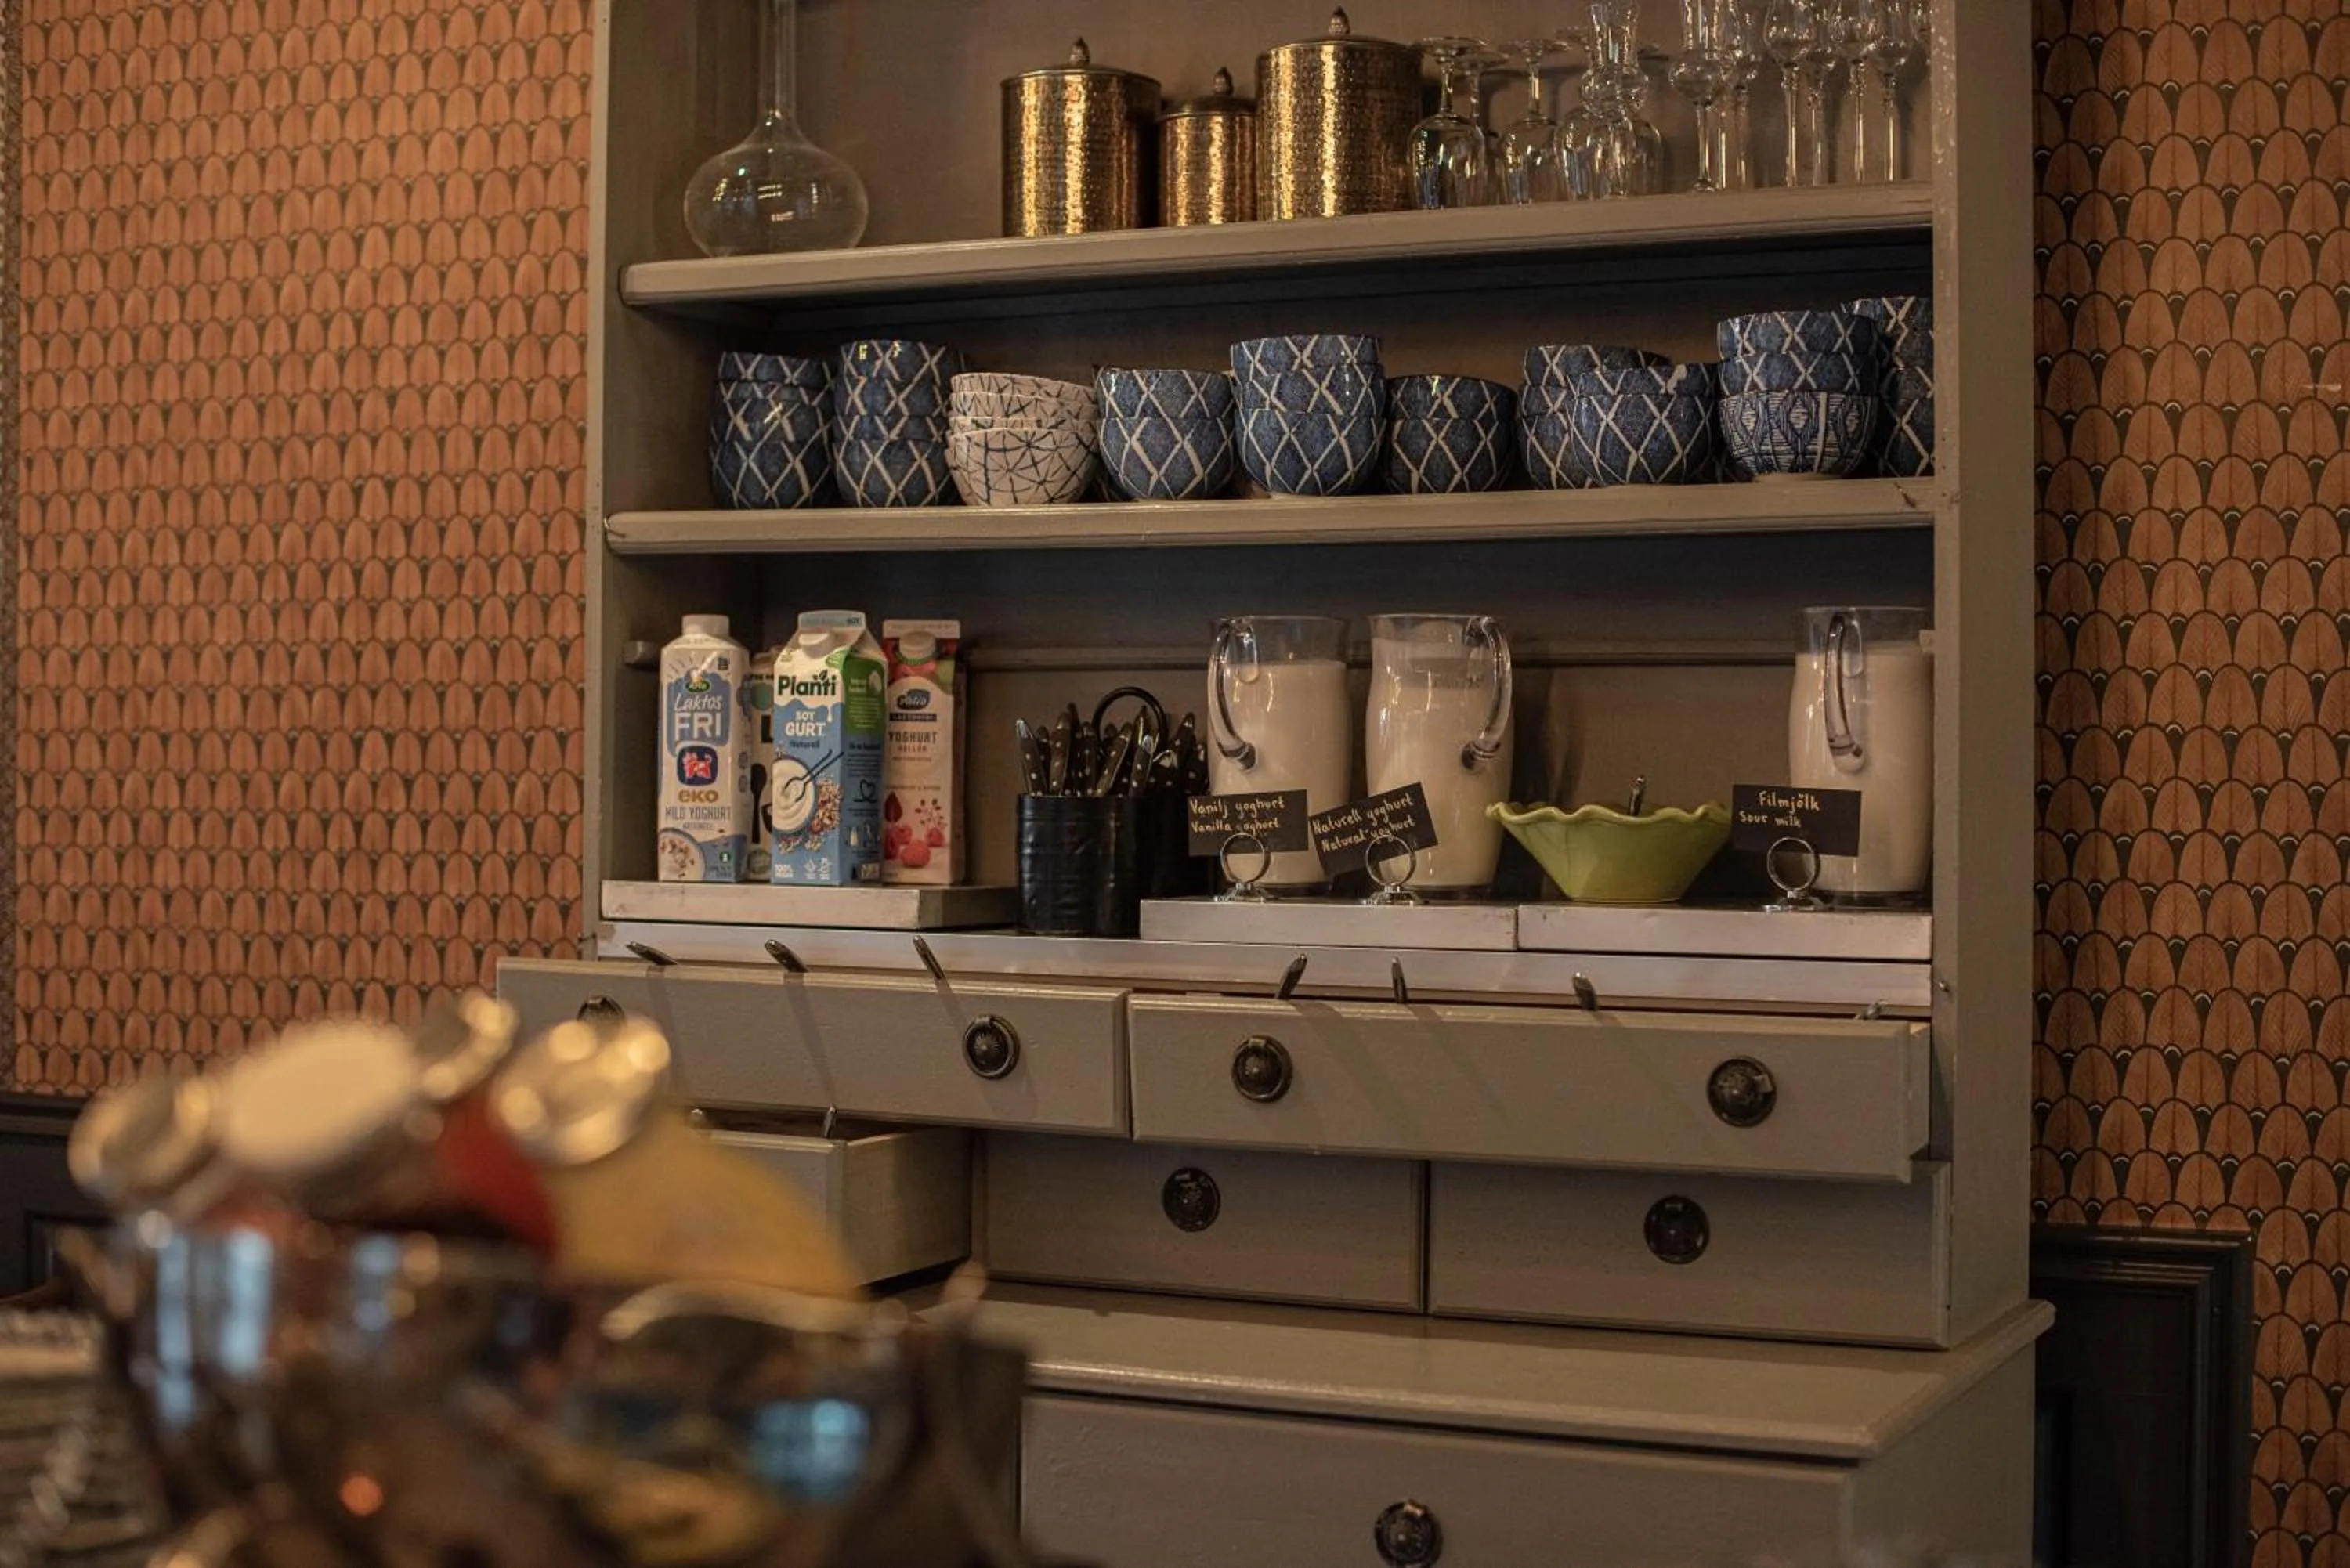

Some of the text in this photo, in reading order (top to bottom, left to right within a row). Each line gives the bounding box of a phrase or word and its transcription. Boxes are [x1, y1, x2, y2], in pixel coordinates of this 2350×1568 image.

[778, 674, 837, 696] Planti
[674, 692, 722, 711] Laktos
[795, 710, 816, 721] SOY
[674, 712, 722, 741] FRI
[786, 721, 826, 737] GURT
[888, 732, 938, 744] YOGHURT
[1190, 795, 1285, 819] Vanilj yoghurt
[1758, 789, 1820, 814] Filmjölk
[665, 805, 732, 822] MILD YOGHURT
[1312, 792, 1415, 835] Naturell yoghurt
[1739, 810, 1802, 828] Sour milk
[1190, 820, 1233, 833] Vanilla
[1321, 828, 1367, 852] Natural
